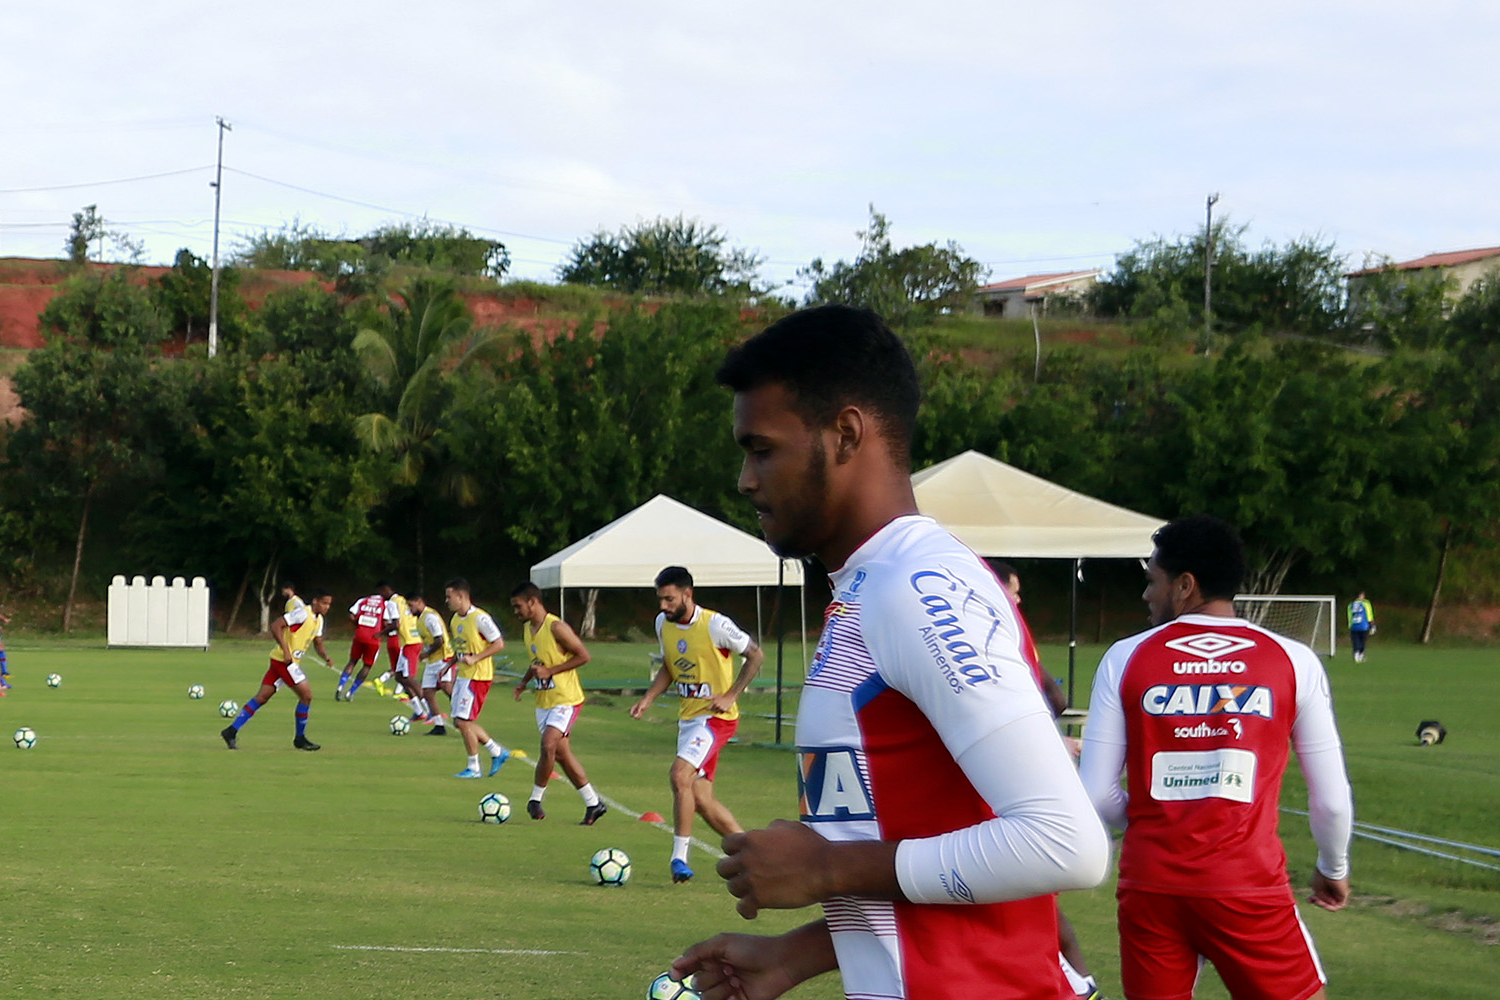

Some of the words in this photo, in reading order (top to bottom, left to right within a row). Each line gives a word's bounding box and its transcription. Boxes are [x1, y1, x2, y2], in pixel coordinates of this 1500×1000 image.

[910, 570, 1002, 688] Canaã
[918, 625, 965, 695] Alimentos
[1173, 659, 1247, 674] umbro
[675, 682, 712, 698] AIXA
[1141, 684, 1274, 719] CAIXA
[1163, 773, 1219, 788] Unimed
